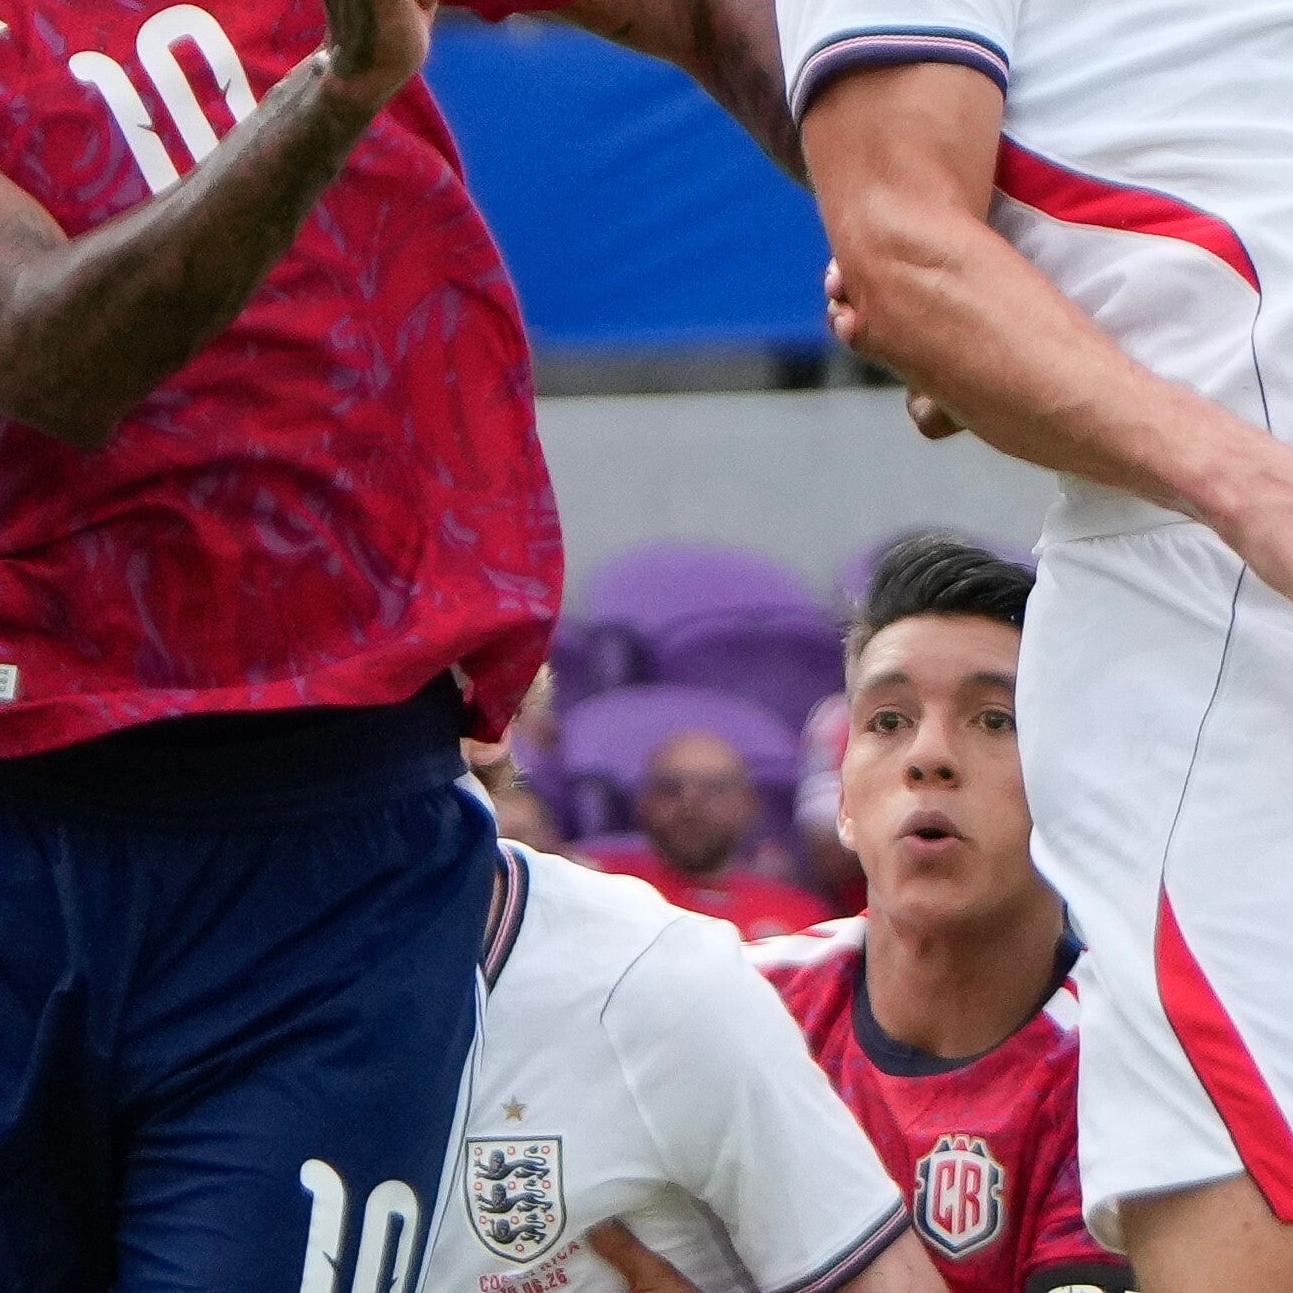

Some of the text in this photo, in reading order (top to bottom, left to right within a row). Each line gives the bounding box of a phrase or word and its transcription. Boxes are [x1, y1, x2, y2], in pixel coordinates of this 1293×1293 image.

[68, 4, 257, 197] 10
[300, 1159, 418, 1293] 10
[932, 1159, 981, 1235] CR
